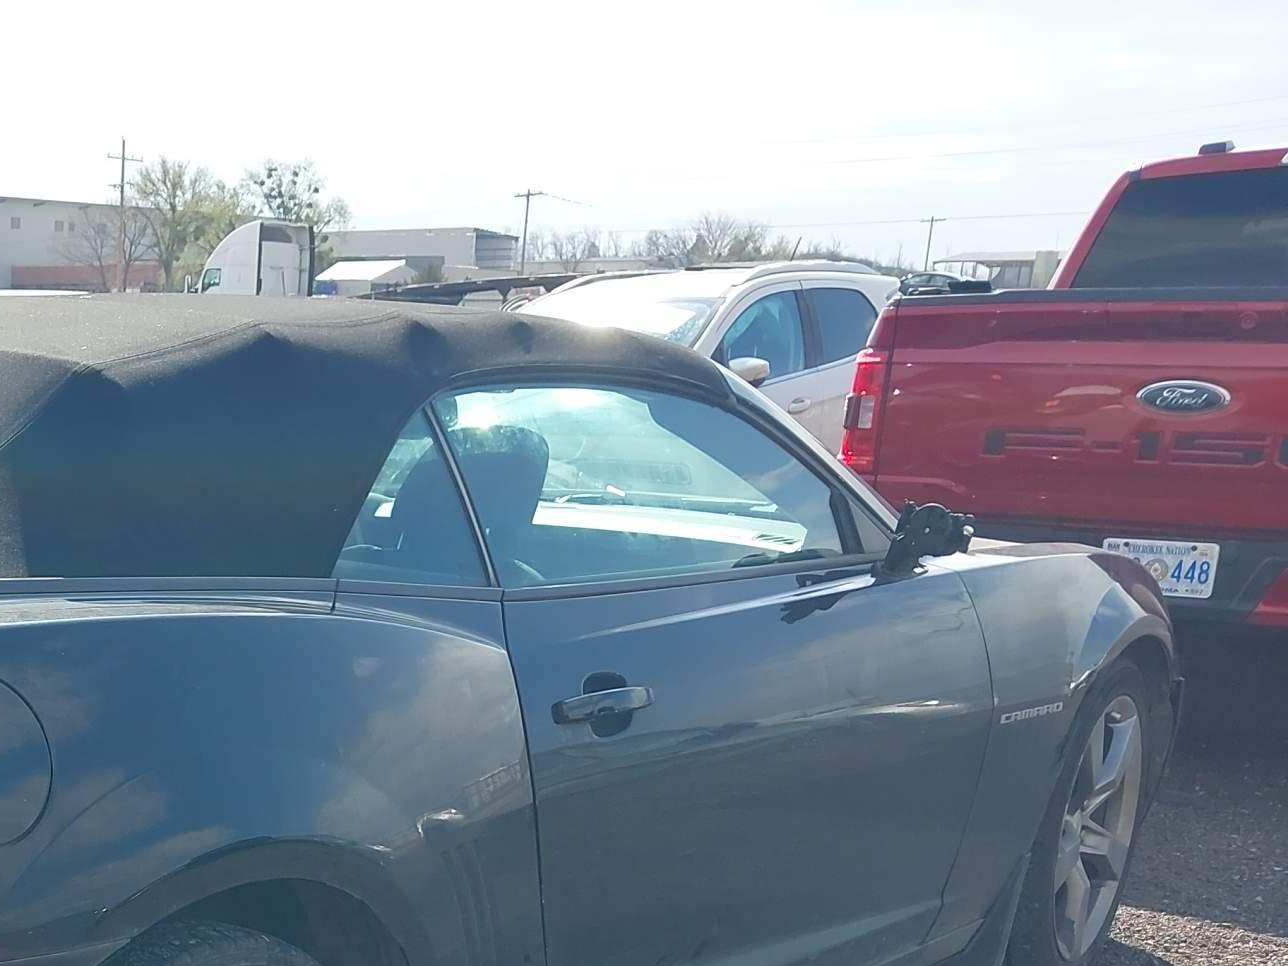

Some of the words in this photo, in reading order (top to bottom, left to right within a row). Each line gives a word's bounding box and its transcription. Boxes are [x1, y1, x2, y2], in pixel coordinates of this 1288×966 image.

[1156, 387, 1208, 410] Ford
[1128, 543, 1163, 555] CHEROKEE
[1165, 546, 1192, 556] NATION
[1170, 559, 1211, 585] 448
[1000, 701, 1064, 724] CAMARO
